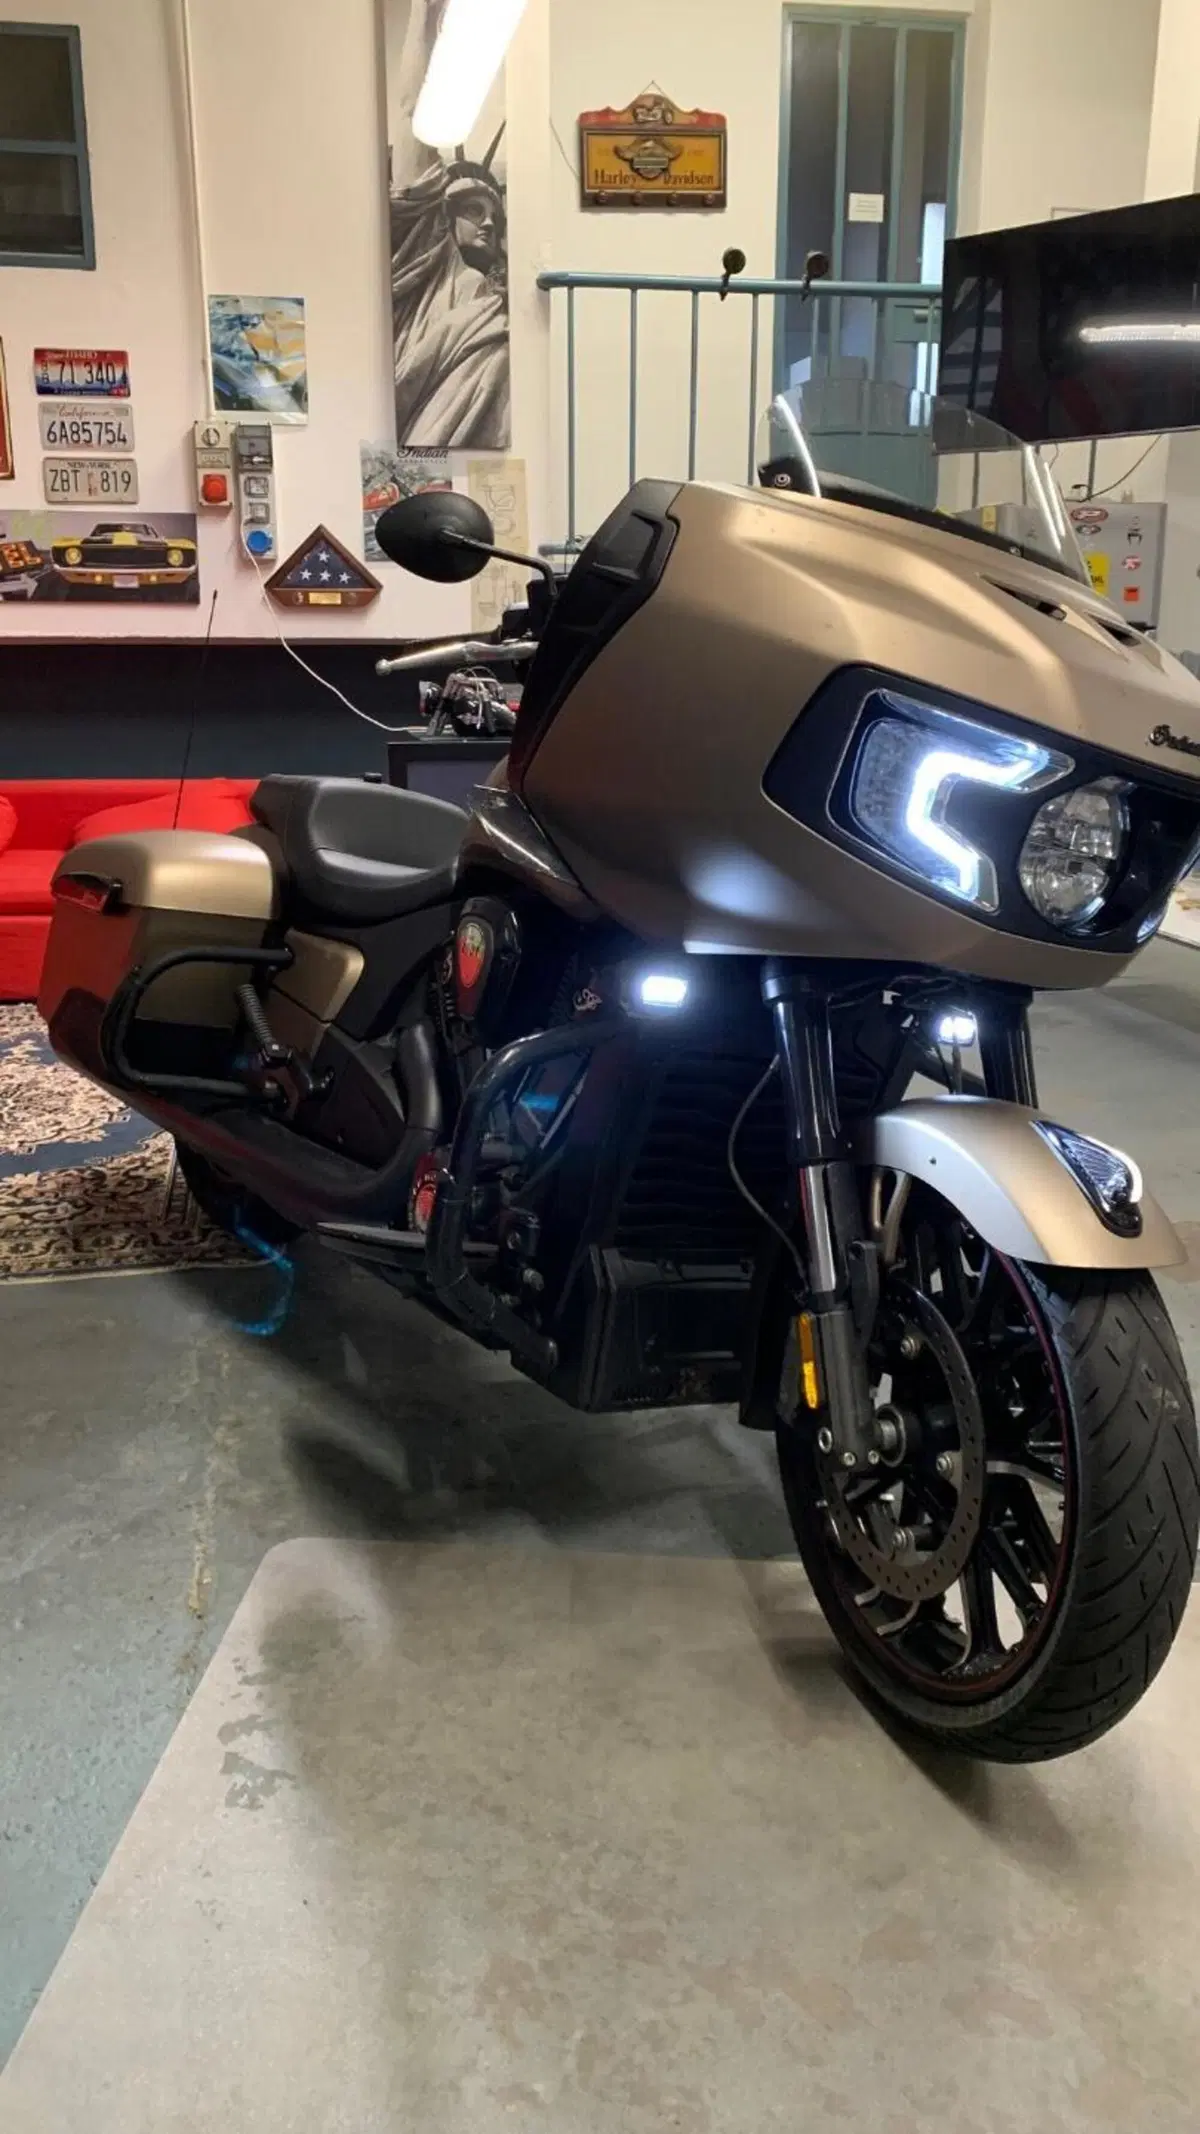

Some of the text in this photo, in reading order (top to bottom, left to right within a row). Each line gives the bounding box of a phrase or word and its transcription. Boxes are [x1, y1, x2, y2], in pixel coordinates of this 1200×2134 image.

[594, 168, 714, 185] Harley Davidson
[60, 360, 116, 385] 71 340
[47, 421, 127, 446] 6A85754
[49, 469, 131, 493] ZBT 819
